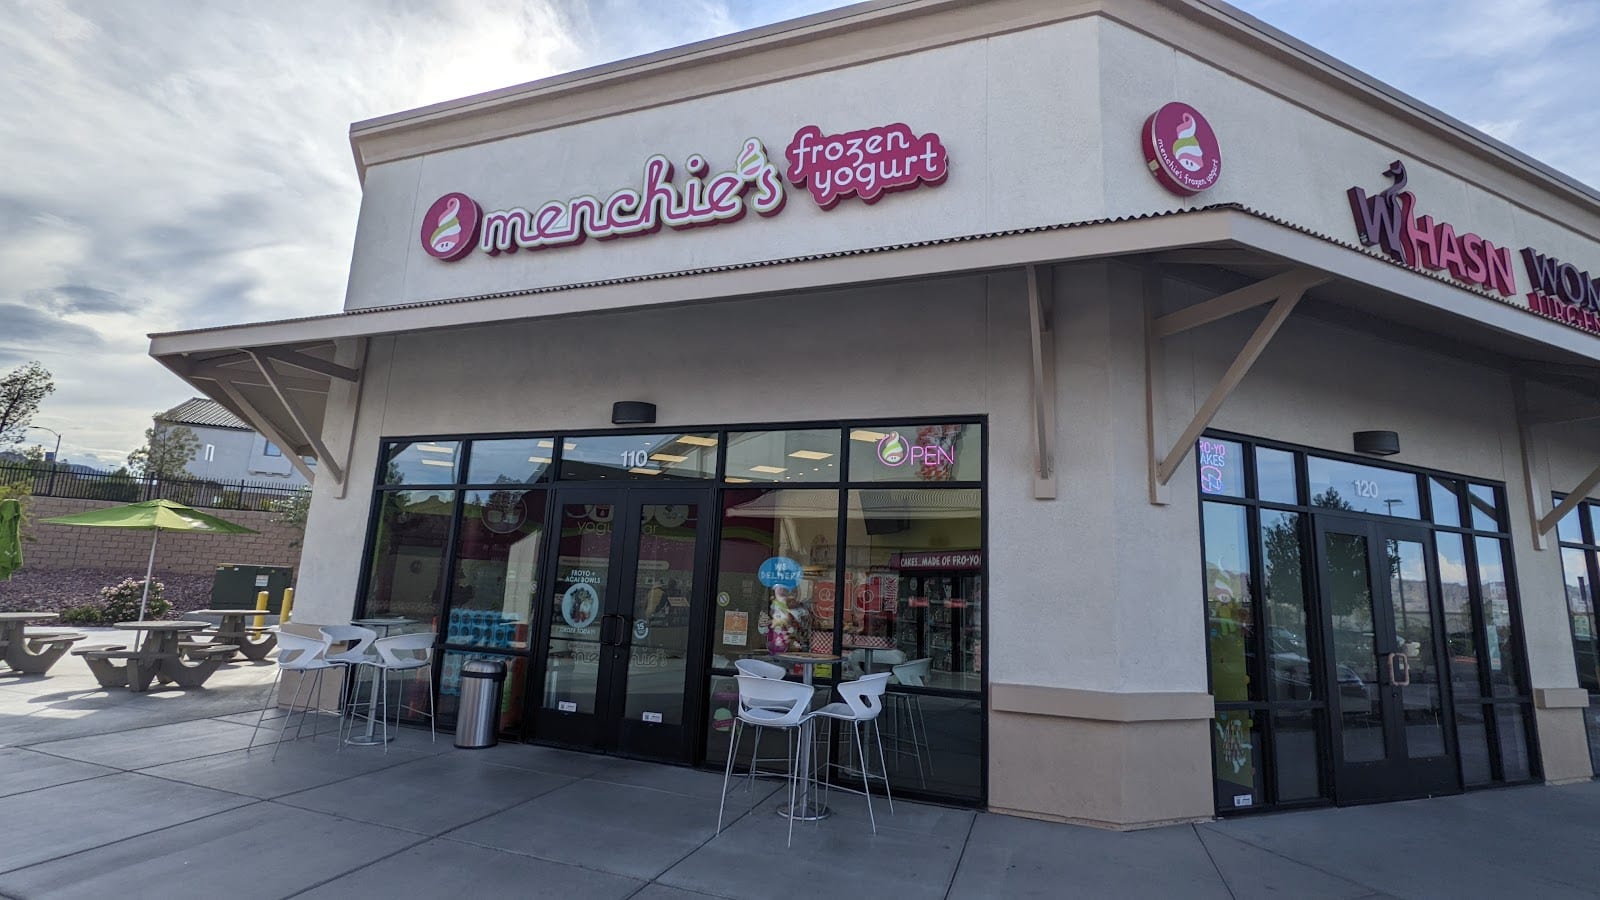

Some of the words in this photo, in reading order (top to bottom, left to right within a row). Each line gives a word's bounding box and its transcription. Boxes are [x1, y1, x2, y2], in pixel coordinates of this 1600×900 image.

[791, 129, 911, 175] frozen
[814, 138, 939, 198] yogurt
[1157, 138, 1182, 179] menchie's
[1184, 173, 1206, 188] frozen
[481, 138, 784, 253] menchie's
[1347, 161, 1516, 297] WHASN
[620, 450, 648, 467] 110
[877, 431, 955, 467] OPEN
[1199, 440, 1225, 456] RO-YO
[1200, 453, 1225, 467] AKES
[1354, 479, 1378, 498] 120
[942, 555, 951, 566] OF
